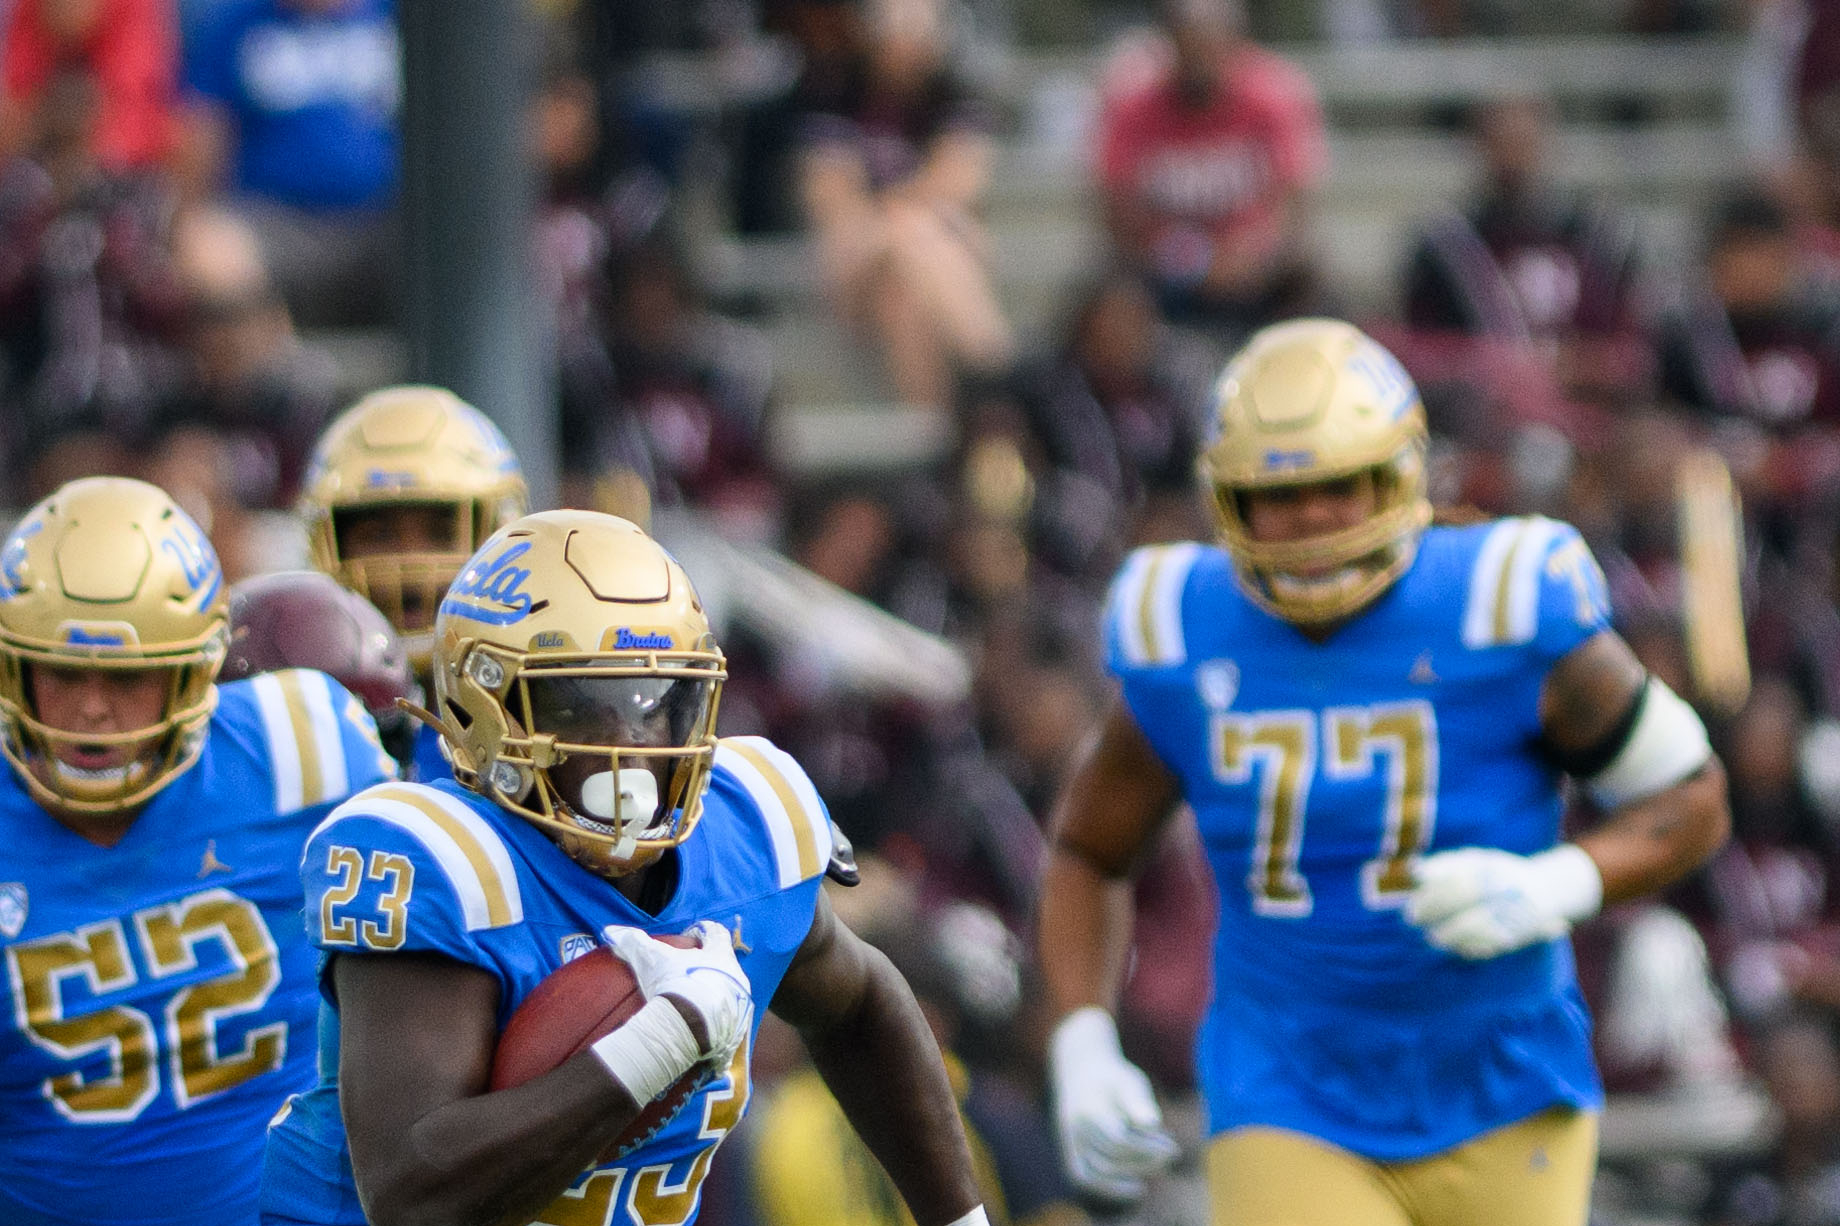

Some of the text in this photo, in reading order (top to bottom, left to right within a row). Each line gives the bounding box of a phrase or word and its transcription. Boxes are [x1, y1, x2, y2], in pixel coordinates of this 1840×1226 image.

[613, 628, 674, 649] Bruins
[1209, 698, 1440, 919] 77
[321, 845, 415, 950] 23
[6, 886, 289, 1122] 52
